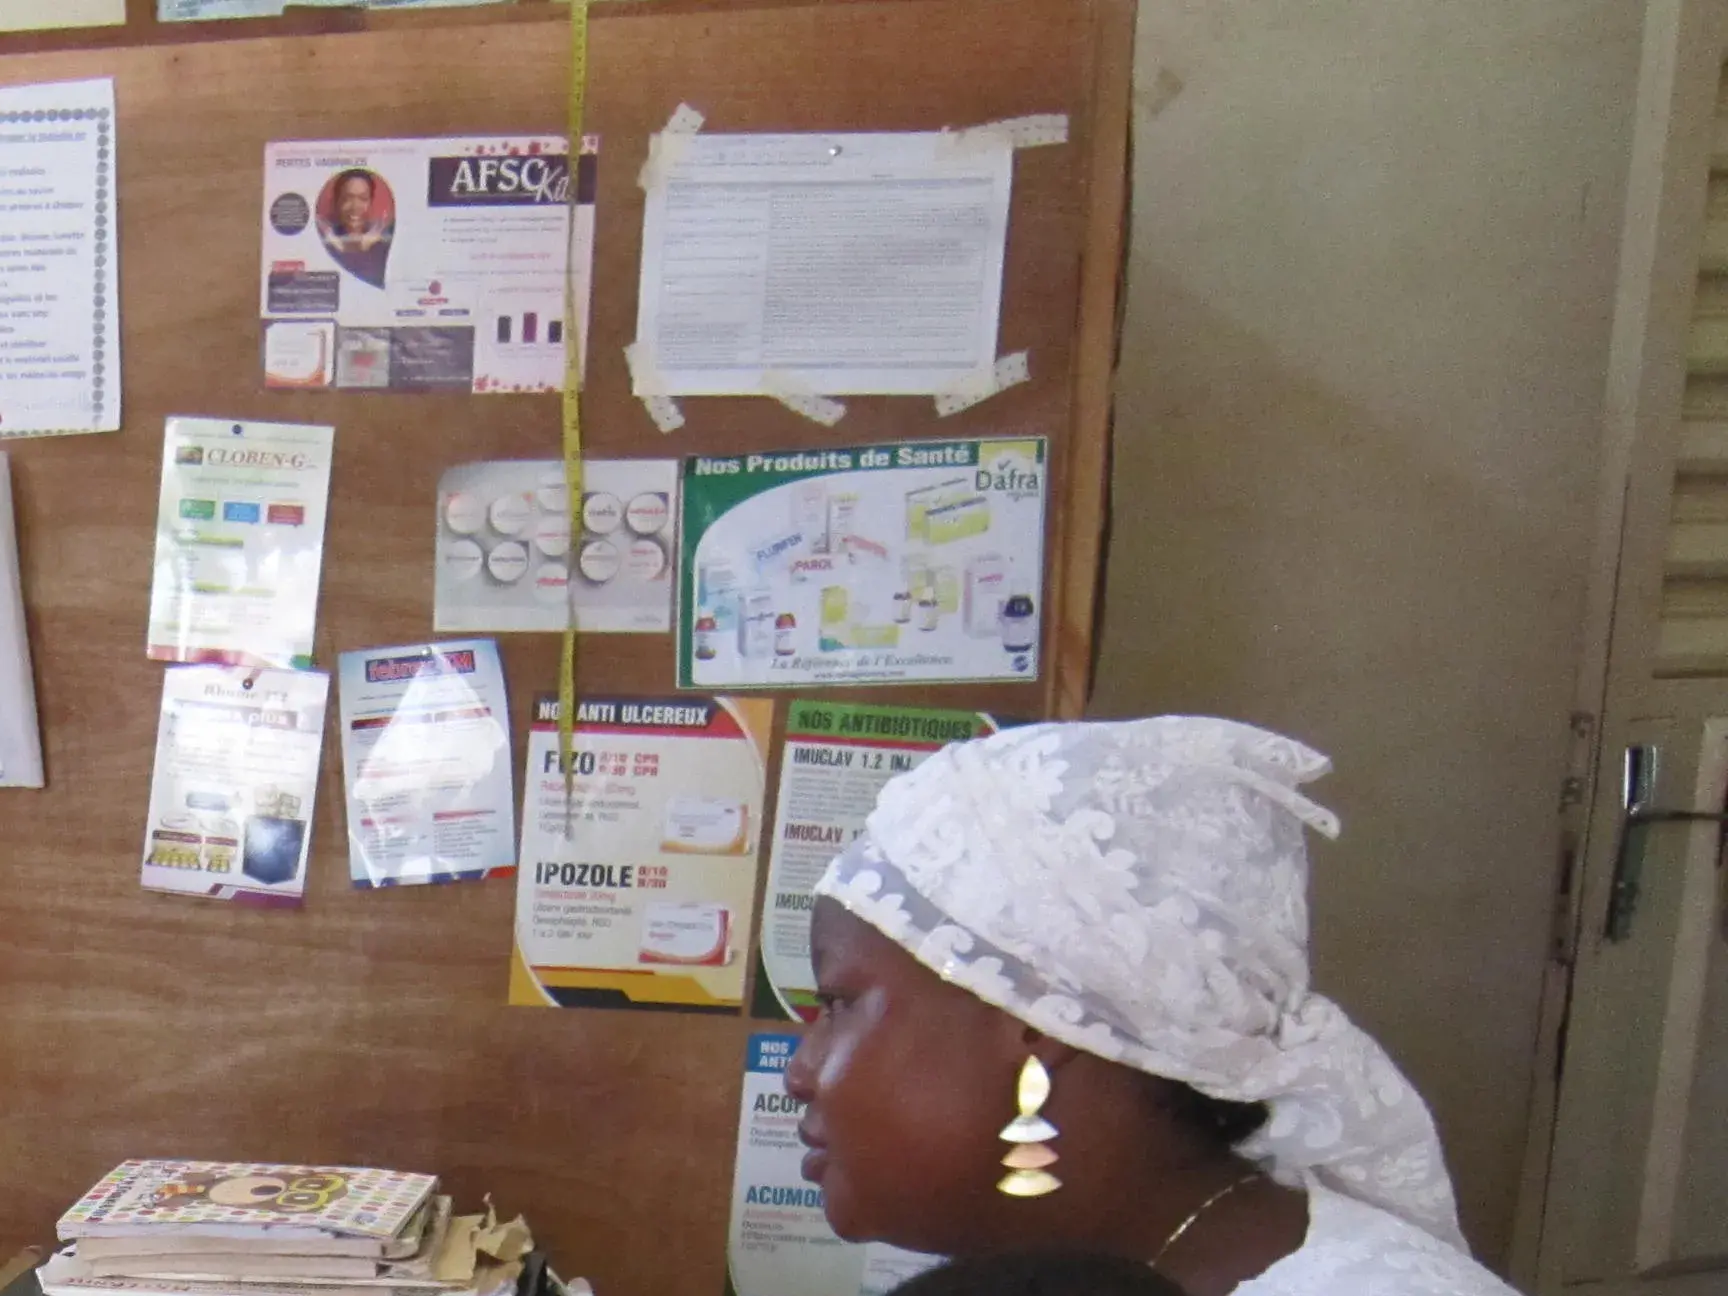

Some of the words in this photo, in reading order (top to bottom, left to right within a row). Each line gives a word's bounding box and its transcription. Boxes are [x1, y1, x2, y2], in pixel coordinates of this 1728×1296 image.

[451, 157, 544, 192] AFSC
[695, 457, 740, 475] Nos
[747, 453, 852, 473] Produits
[859, 448, 889, 467] de
[897, 444, 970, 465] Santé
[975, 468, 1039, 491] Dafra
[538, 702, 562, 719] NO
[577, 705, 615, 722] ANTI
[622, 705, 709, 725] ULCEREUX
[797, 709, 833, 729] NOS
[838, 712, 973, 739] ANTIBIOTIQUES
[793, 748, 853, 767] IMUCLAV
[861, 752, 883, 769] 1.2
[784, 822, 843, 843] IMUCLAV
[535, 862, 633, 888] IPOZOLE
[759, 1040, 789, 1054] NOS
